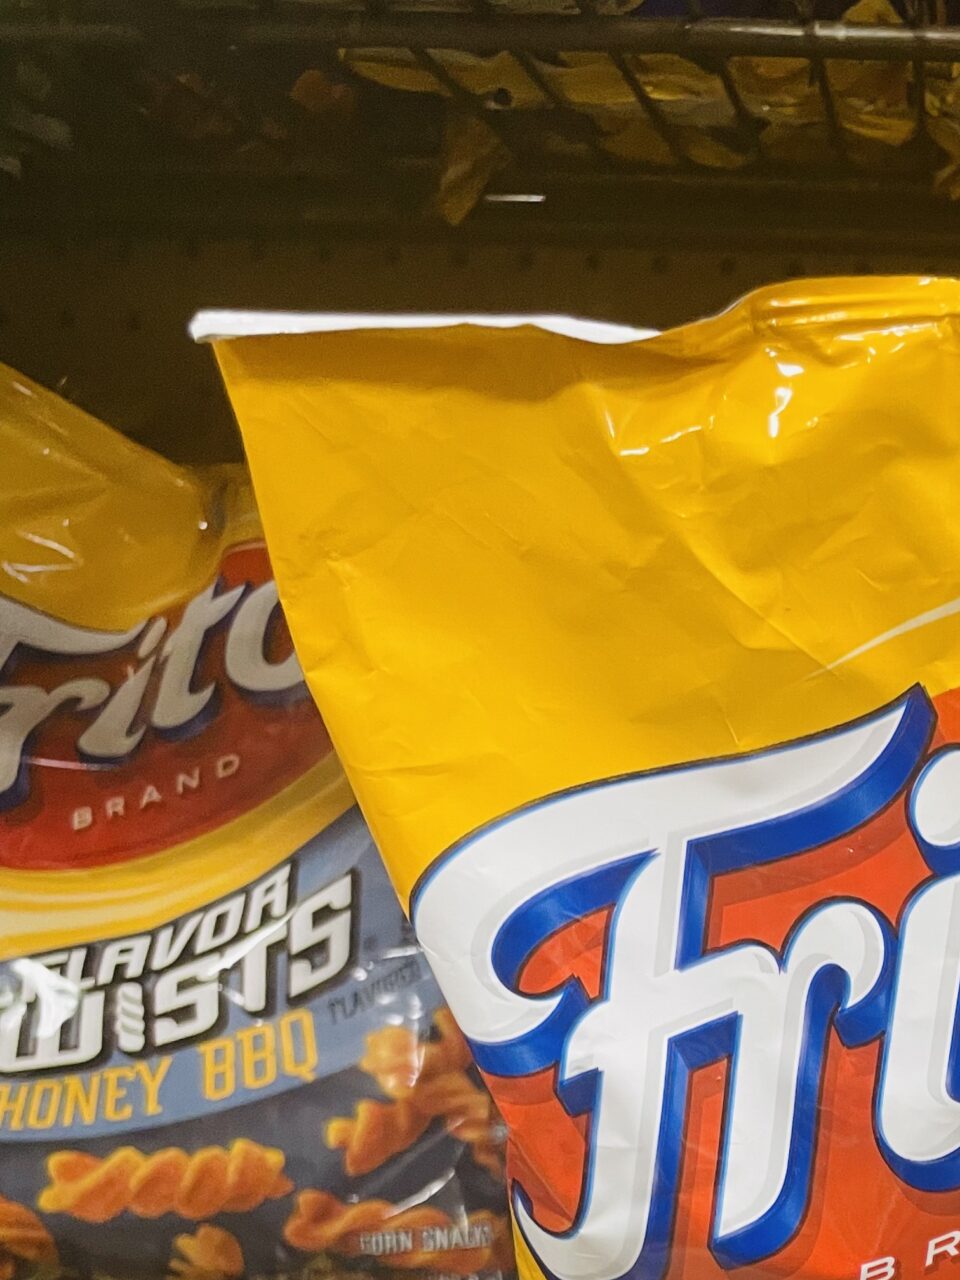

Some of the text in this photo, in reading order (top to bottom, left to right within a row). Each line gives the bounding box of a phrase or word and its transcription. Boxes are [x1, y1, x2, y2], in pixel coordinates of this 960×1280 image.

[72, 753, 240, 830] BRAND
[0, 1008, 320, 1131] HONEY BBQ
